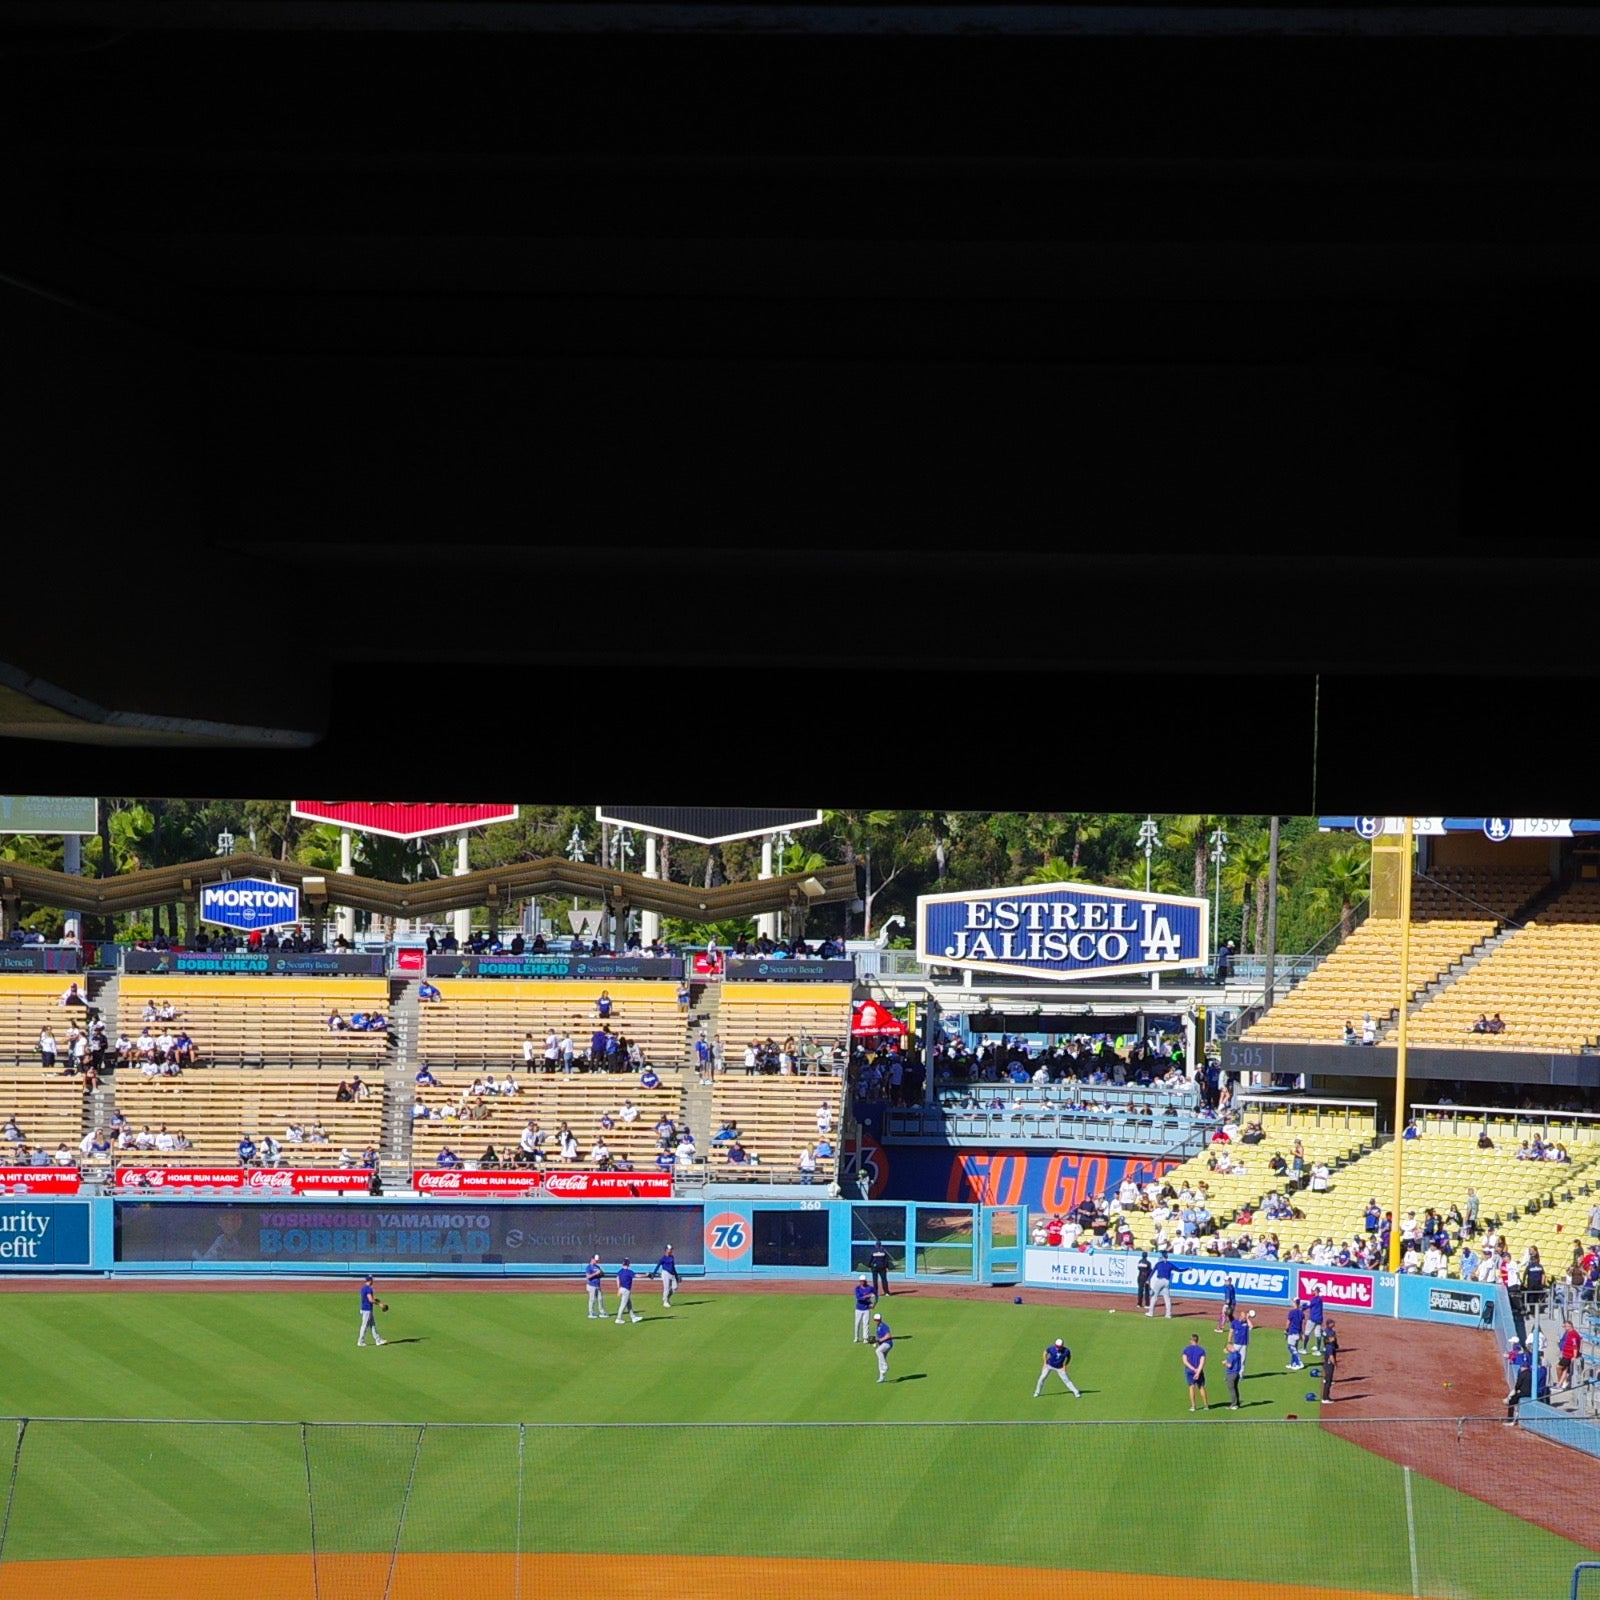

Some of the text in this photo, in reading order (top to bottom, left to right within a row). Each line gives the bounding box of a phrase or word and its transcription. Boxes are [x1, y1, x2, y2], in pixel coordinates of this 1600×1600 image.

[1522, 818, 1560, 833] 1959
[205, 889, 294, 908] MORTON
[964, 901, 1181, 961] ESTREL LA
[945, 931, 1130, 961] JALISCO
[4, 957, 35, 968] Benefit
[177, 959, 268, 971] BOBBLEHEAD
[287, 960, 340, 970] Security Benefit
[478, 964, 569, 975] BOBBLEHEAD
[769, 966, 824, 975] Security Benefit
[1229, 1046, 1263, 1066] 5:05
[7, 1173, 22, 1182] HIT
[24, 1173, 54, 1182] EVERY
[55, 1173, 77, 1182] TIME
[250, 1171, 295, 1187] Coca-Cola
[296, 1175, 351, 1183] A HIT EVERY
[419, 1173, 462, 1189] Coca-Cola
[463, 1178, 534, 1186] HOME RUN MAGIC
[546, 1174, 589, 1190] Coca-Cola
[592, 1179, 669, 1187] A HIT EVERY TIME
[1042, 1149, 1108, 1216] GO
[800, 1201, 821, 1210] 360
[259, 1213, 491, 1229] YOSHINOBU YAMAMOTO
[259, 1229, 491, 1254] BOBBLEHEAD
[528, 1231, 636, 1248] Security Benefit
[713, 1223, 745, 1249] 76
[1051, 1264, 1106, 1277] MERRILL
[1170, 1267, 1285, 1292] TOYO TIRES
[1379, 1276, 1395, 1287] 330
[1300, 1276, 1371, 1302] Yakult
